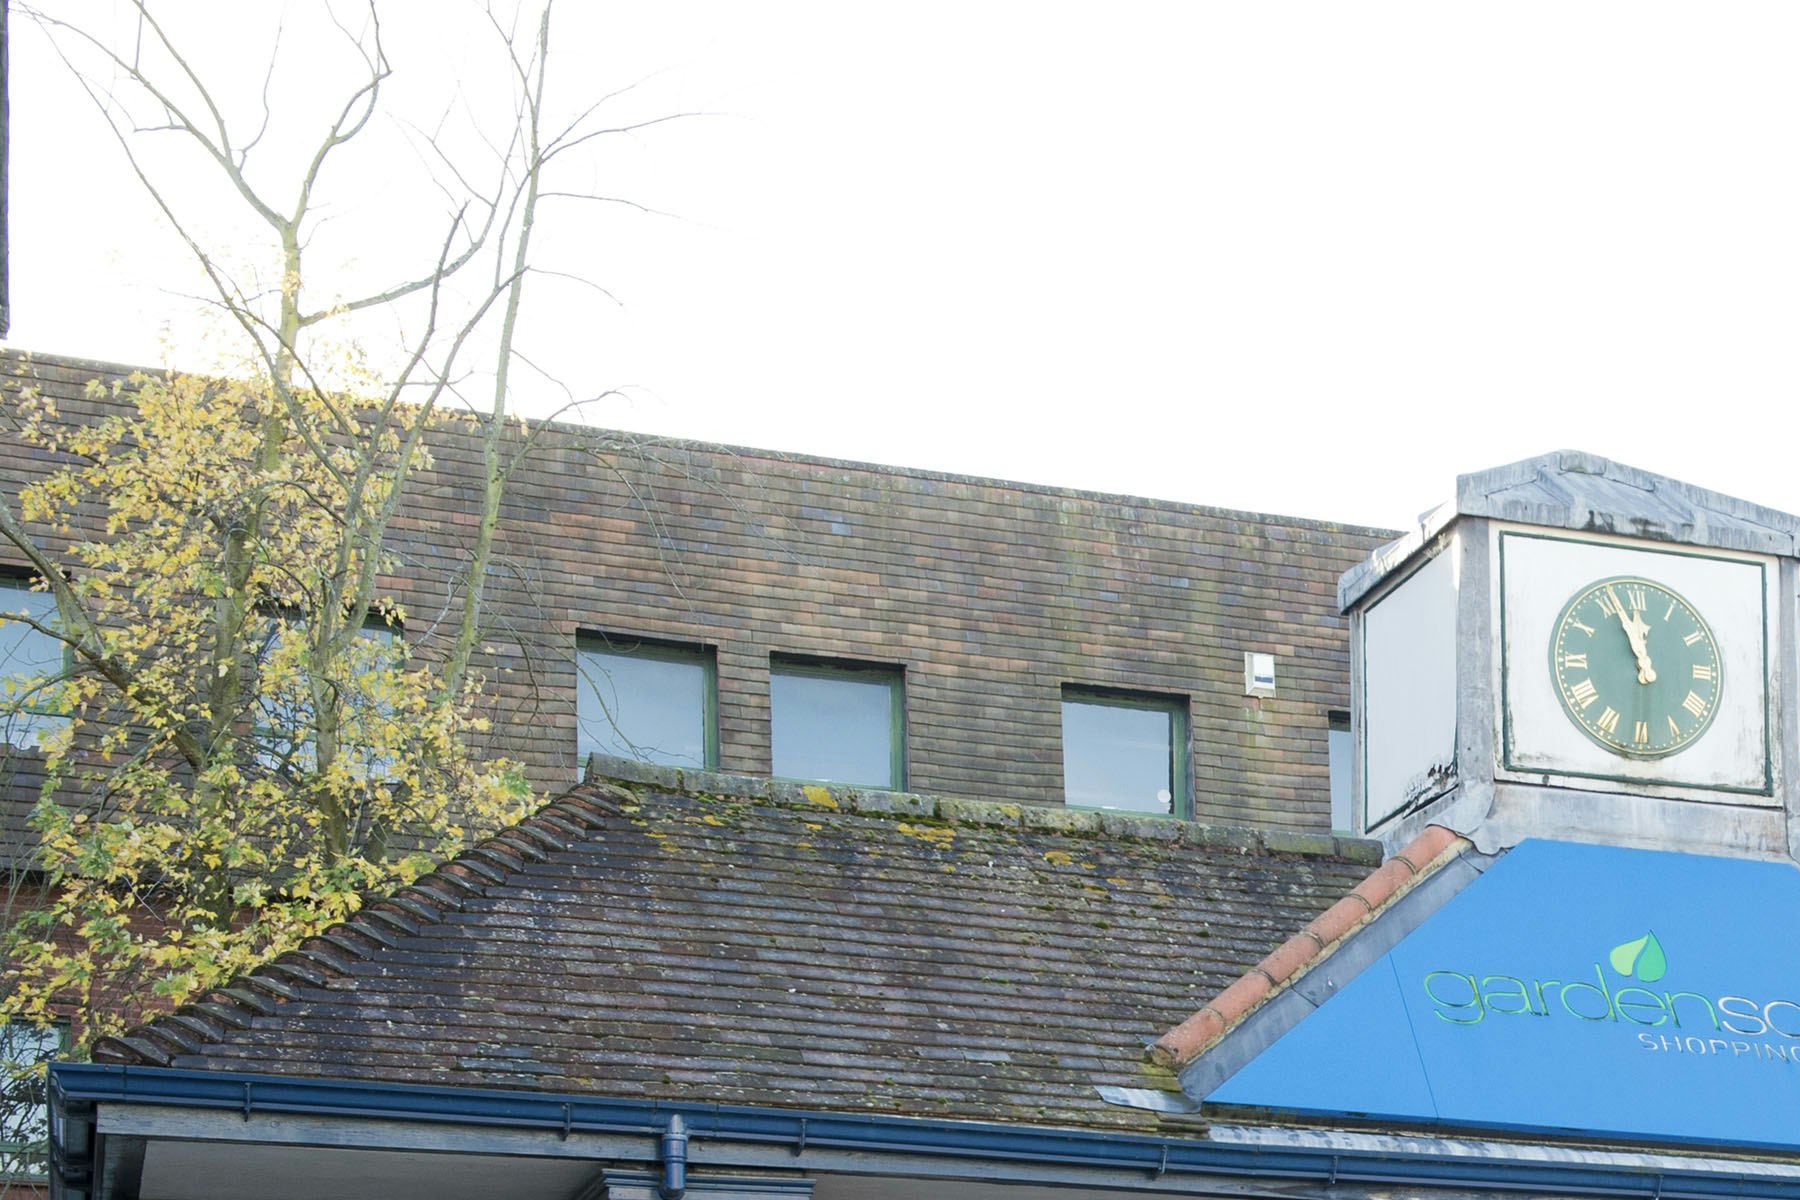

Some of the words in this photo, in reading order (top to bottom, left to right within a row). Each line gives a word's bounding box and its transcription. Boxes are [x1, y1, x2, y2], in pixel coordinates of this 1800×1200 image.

[1628, 590, 1647, 611] XII
[1683, 630, 1704, 647] II
[1564, 651, 1588, 670] IX
[1692, 664, 1712, 681] III
[1570, 677, 1600, 710] VIII
[1597, 706, 1620, 734] VII
[1634, 720, 1648, 744] VI
